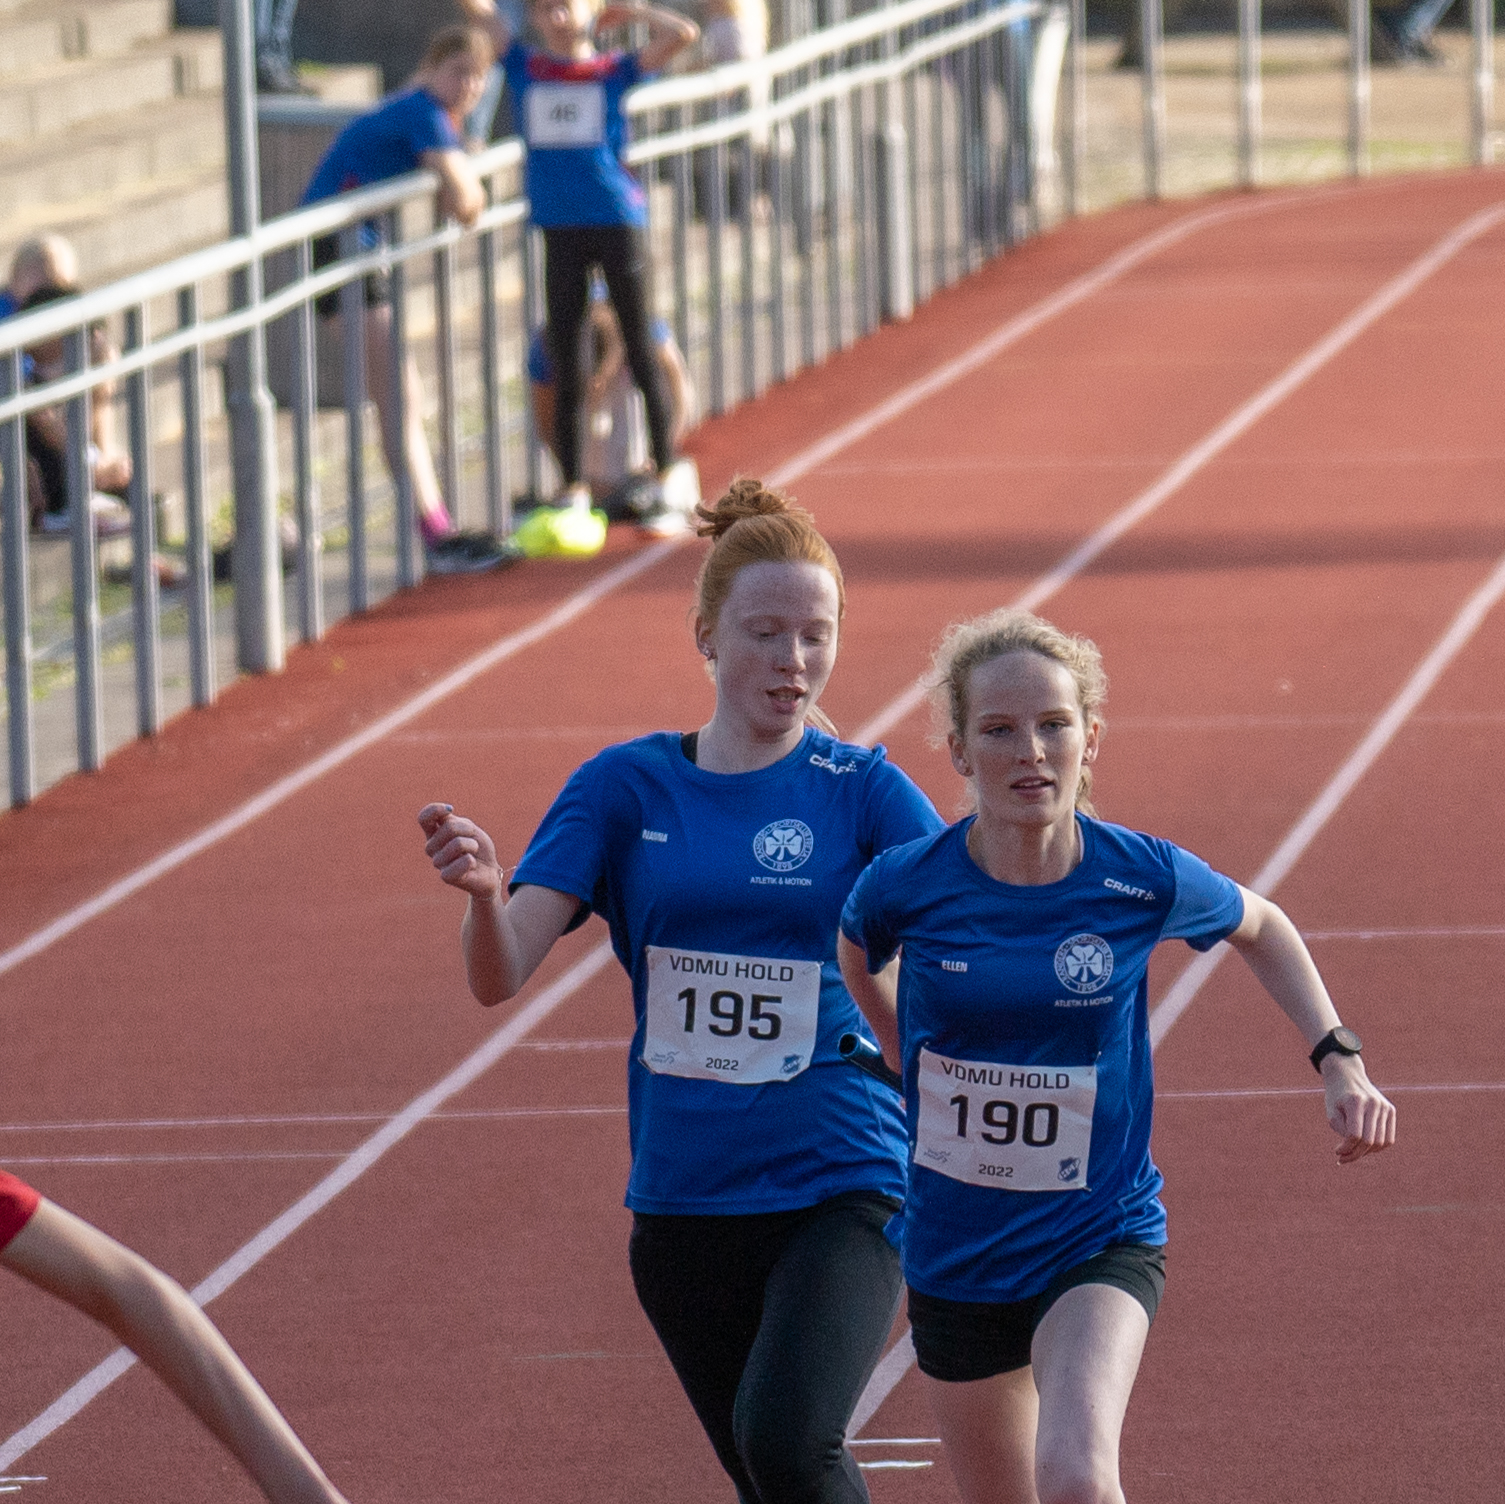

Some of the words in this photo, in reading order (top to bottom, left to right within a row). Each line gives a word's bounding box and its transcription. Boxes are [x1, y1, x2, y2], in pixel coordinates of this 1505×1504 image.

[809, 753, 847, 775] CRAF
[1103, 878, 1146, 898] CRAFT
[670, 955, 728, 976] VDMU
[735, 962, 794, 982] HOLD
[941, 960, 968, 972] ELLEN
[677, 987, 783, 1041] 195
[705, 1057, 739, 1071] 2022
[941, 1061, 1002, 1086] VDMU
[1010, 1072, 1069, 1089] HOLD
[950, 1094, 1059, 1147] 190
[978, 1164, 1014, 1178] 2022
